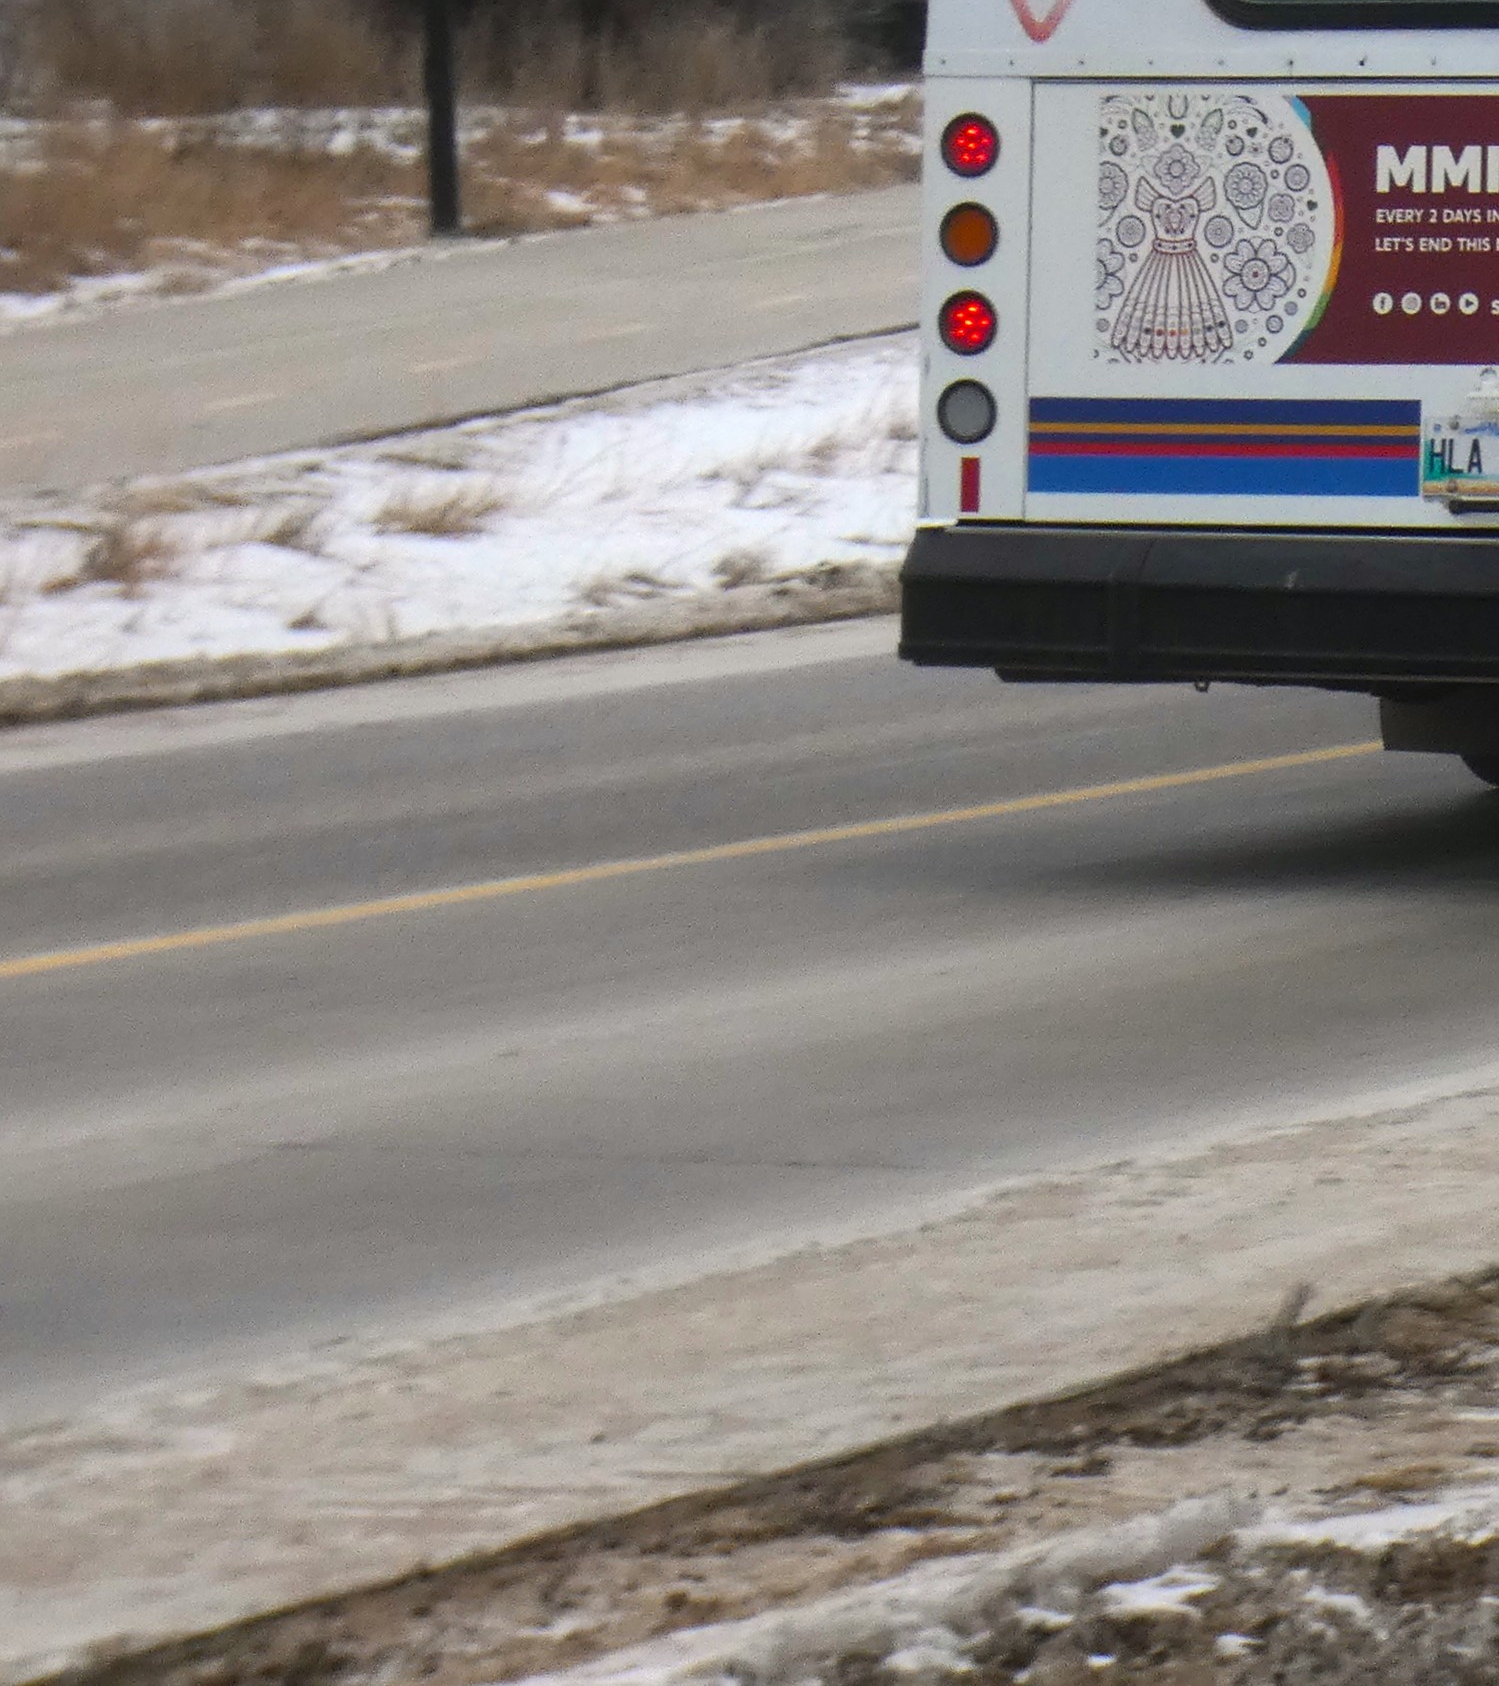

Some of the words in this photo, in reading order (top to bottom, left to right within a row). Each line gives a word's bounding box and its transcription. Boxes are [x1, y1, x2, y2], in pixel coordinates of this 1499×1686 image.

[1375, 209, 1423, 224] EVERY
[1429, 209, 1438, 223] 2
[1442, 209, 1481, 223] DAYS
[1375, 237, 1414, 252] LET'S
[1419, 237, 1452, 252] END
[1457, 237, 1491, 252] THIS
[1429, 438, 1483, 474] HLA
